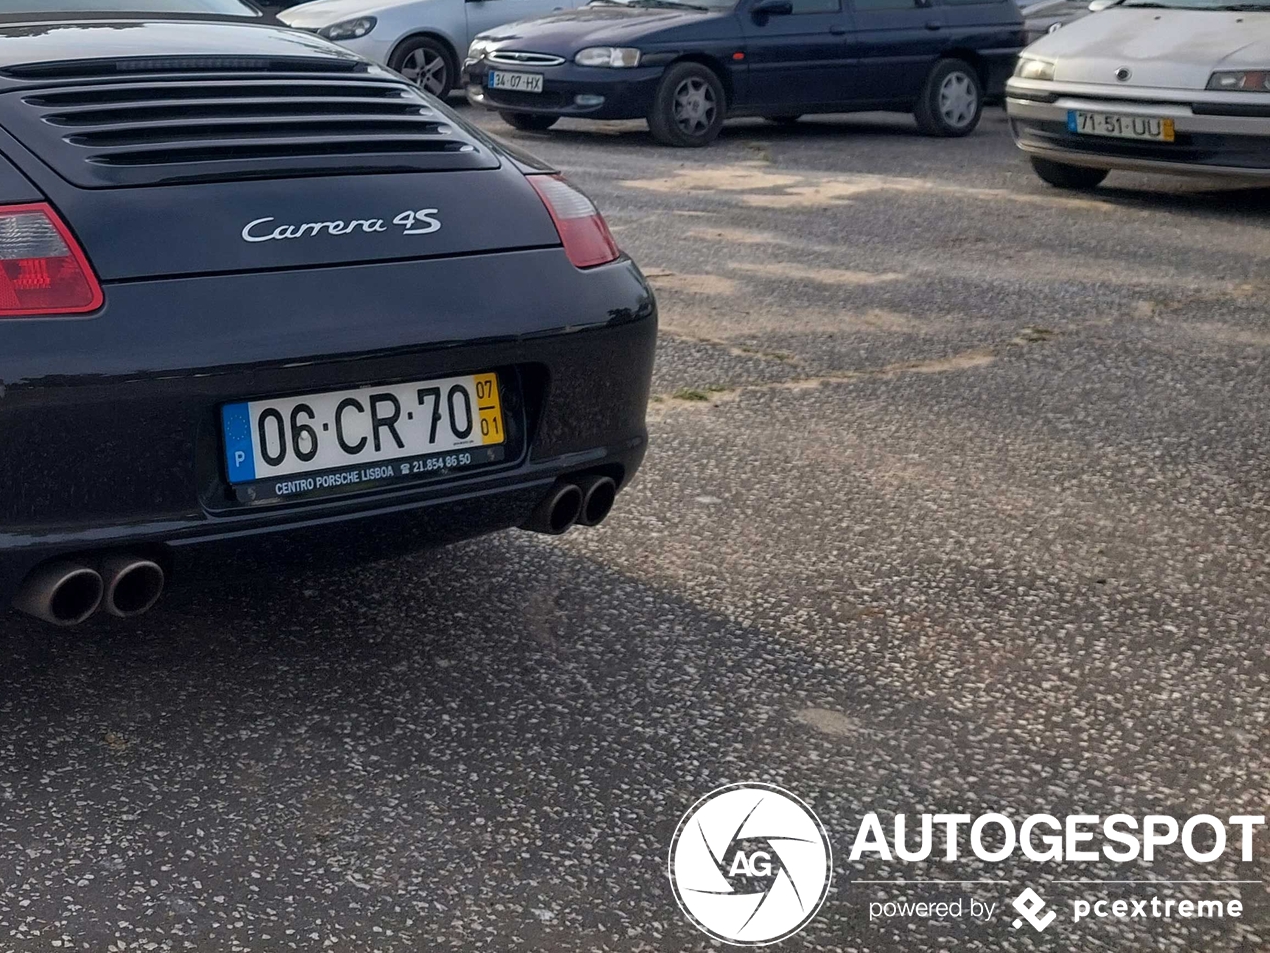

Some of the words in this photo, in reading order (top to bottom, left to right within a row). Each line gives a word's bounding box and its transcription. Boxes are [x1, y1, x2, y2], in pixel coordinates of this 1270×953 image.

[241, 216, 387, 242] Carrera
[392, 208, 442, 235] 4S
[476, 379, 492, 399] 07
[481, 416, 499, 436] 01
[234, 450, 246, 468] P
[275, 478, 314, 495] CENTRO
[316, 471, 360, 489] PORSCHE
[361, 465, 394, 480] LISBOA
[413, 460, 444, 473] 21.854
[446, 455, 457, 467] 86
[459, 453, 472, 465] 50
